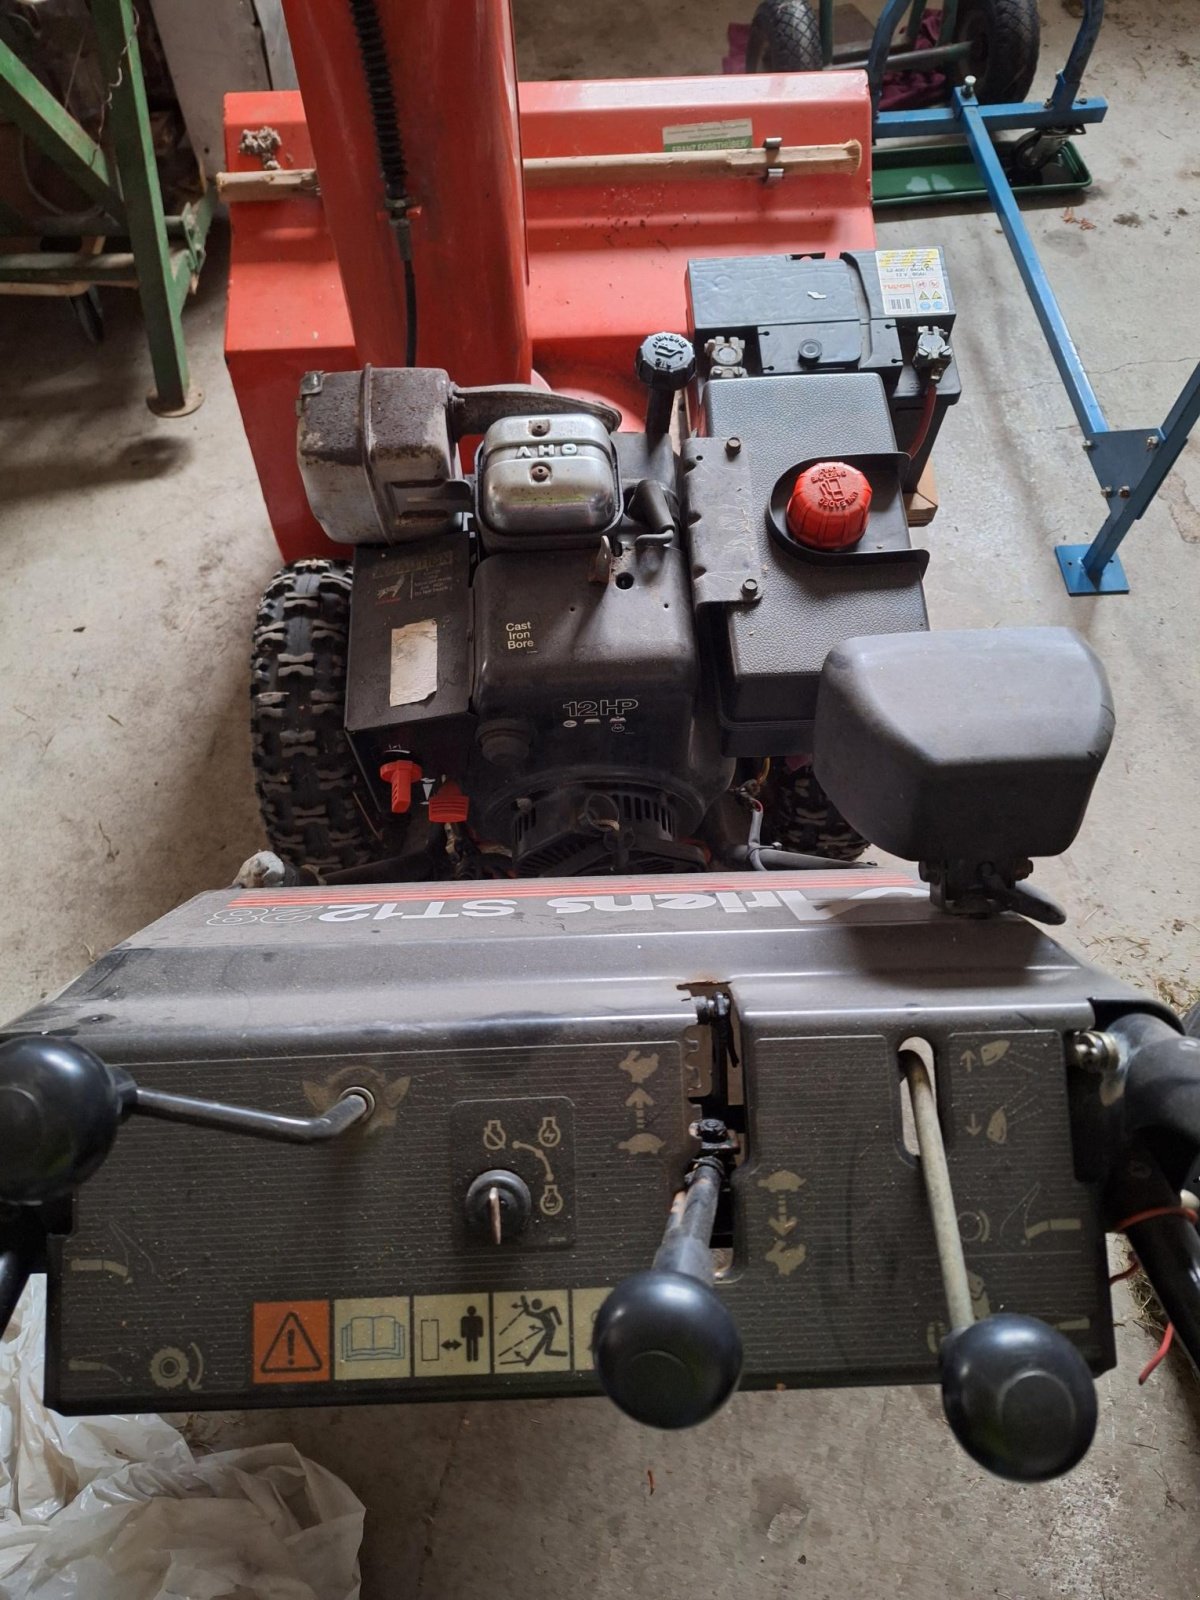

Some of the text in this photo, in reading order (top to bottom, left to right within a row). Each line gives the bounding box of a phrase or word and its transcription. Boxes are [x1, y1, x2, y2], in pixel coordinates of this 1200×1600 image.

[516, 443, 577, 459] OHV
[505, 621, 532, 631] Cast
[508, 631, 531, 640] Iron
[507, 640, 534, 650] Bore
[545, 886, 931, 921] Ariens
